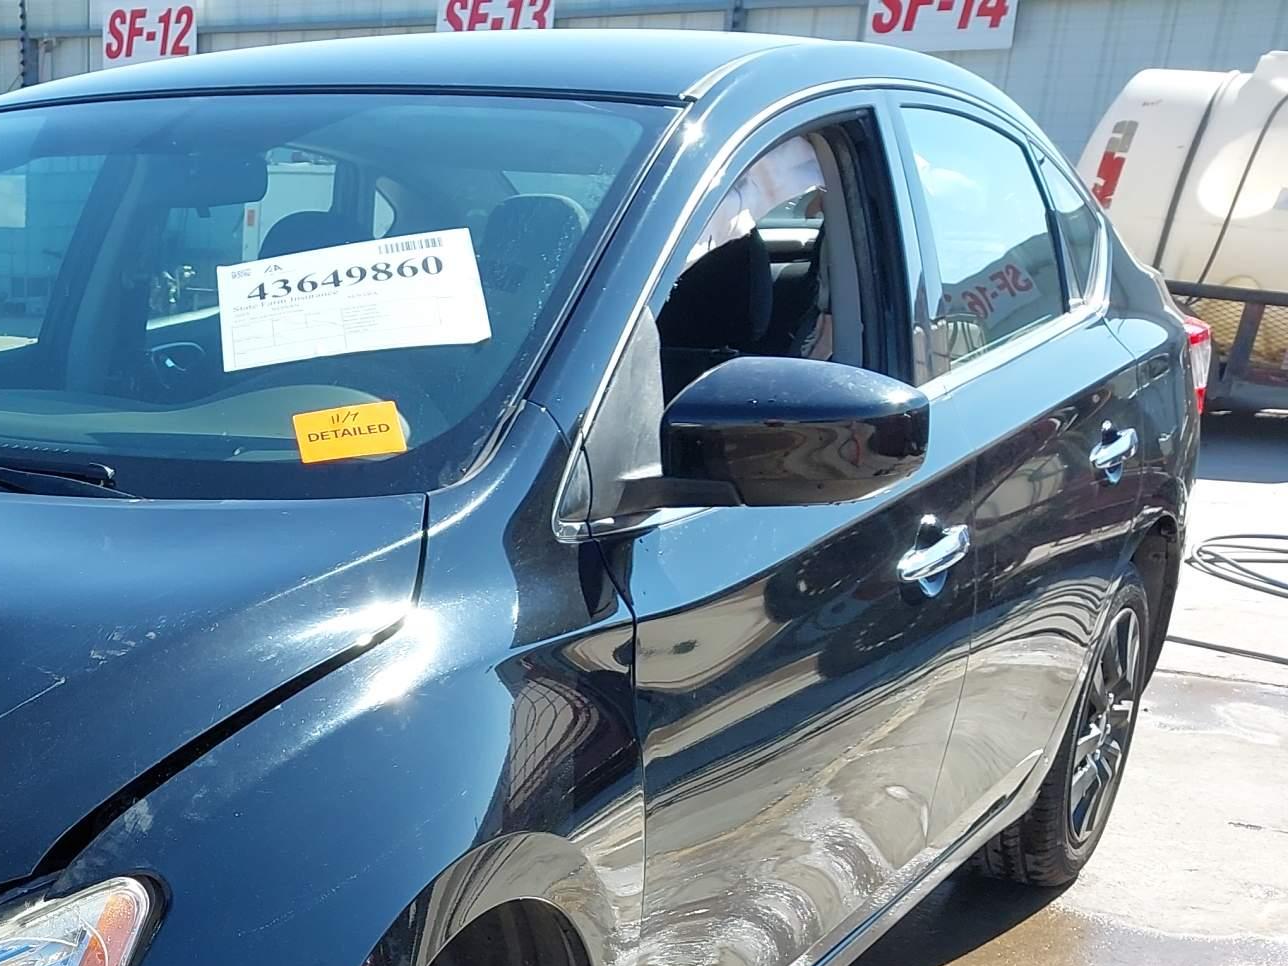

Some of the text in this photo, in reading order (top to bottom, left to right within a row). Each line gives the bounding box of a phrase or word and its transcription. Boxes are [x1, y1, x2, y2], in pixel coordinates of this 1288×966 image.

[105, 6, 194, 59] SF-12
[446, 0, 551, 32] SF-13
[872, 0, 1010, 34] SF-14
[247, 254, 444, 301] 43649860
[307, 418, 391, 443] DETAILED
